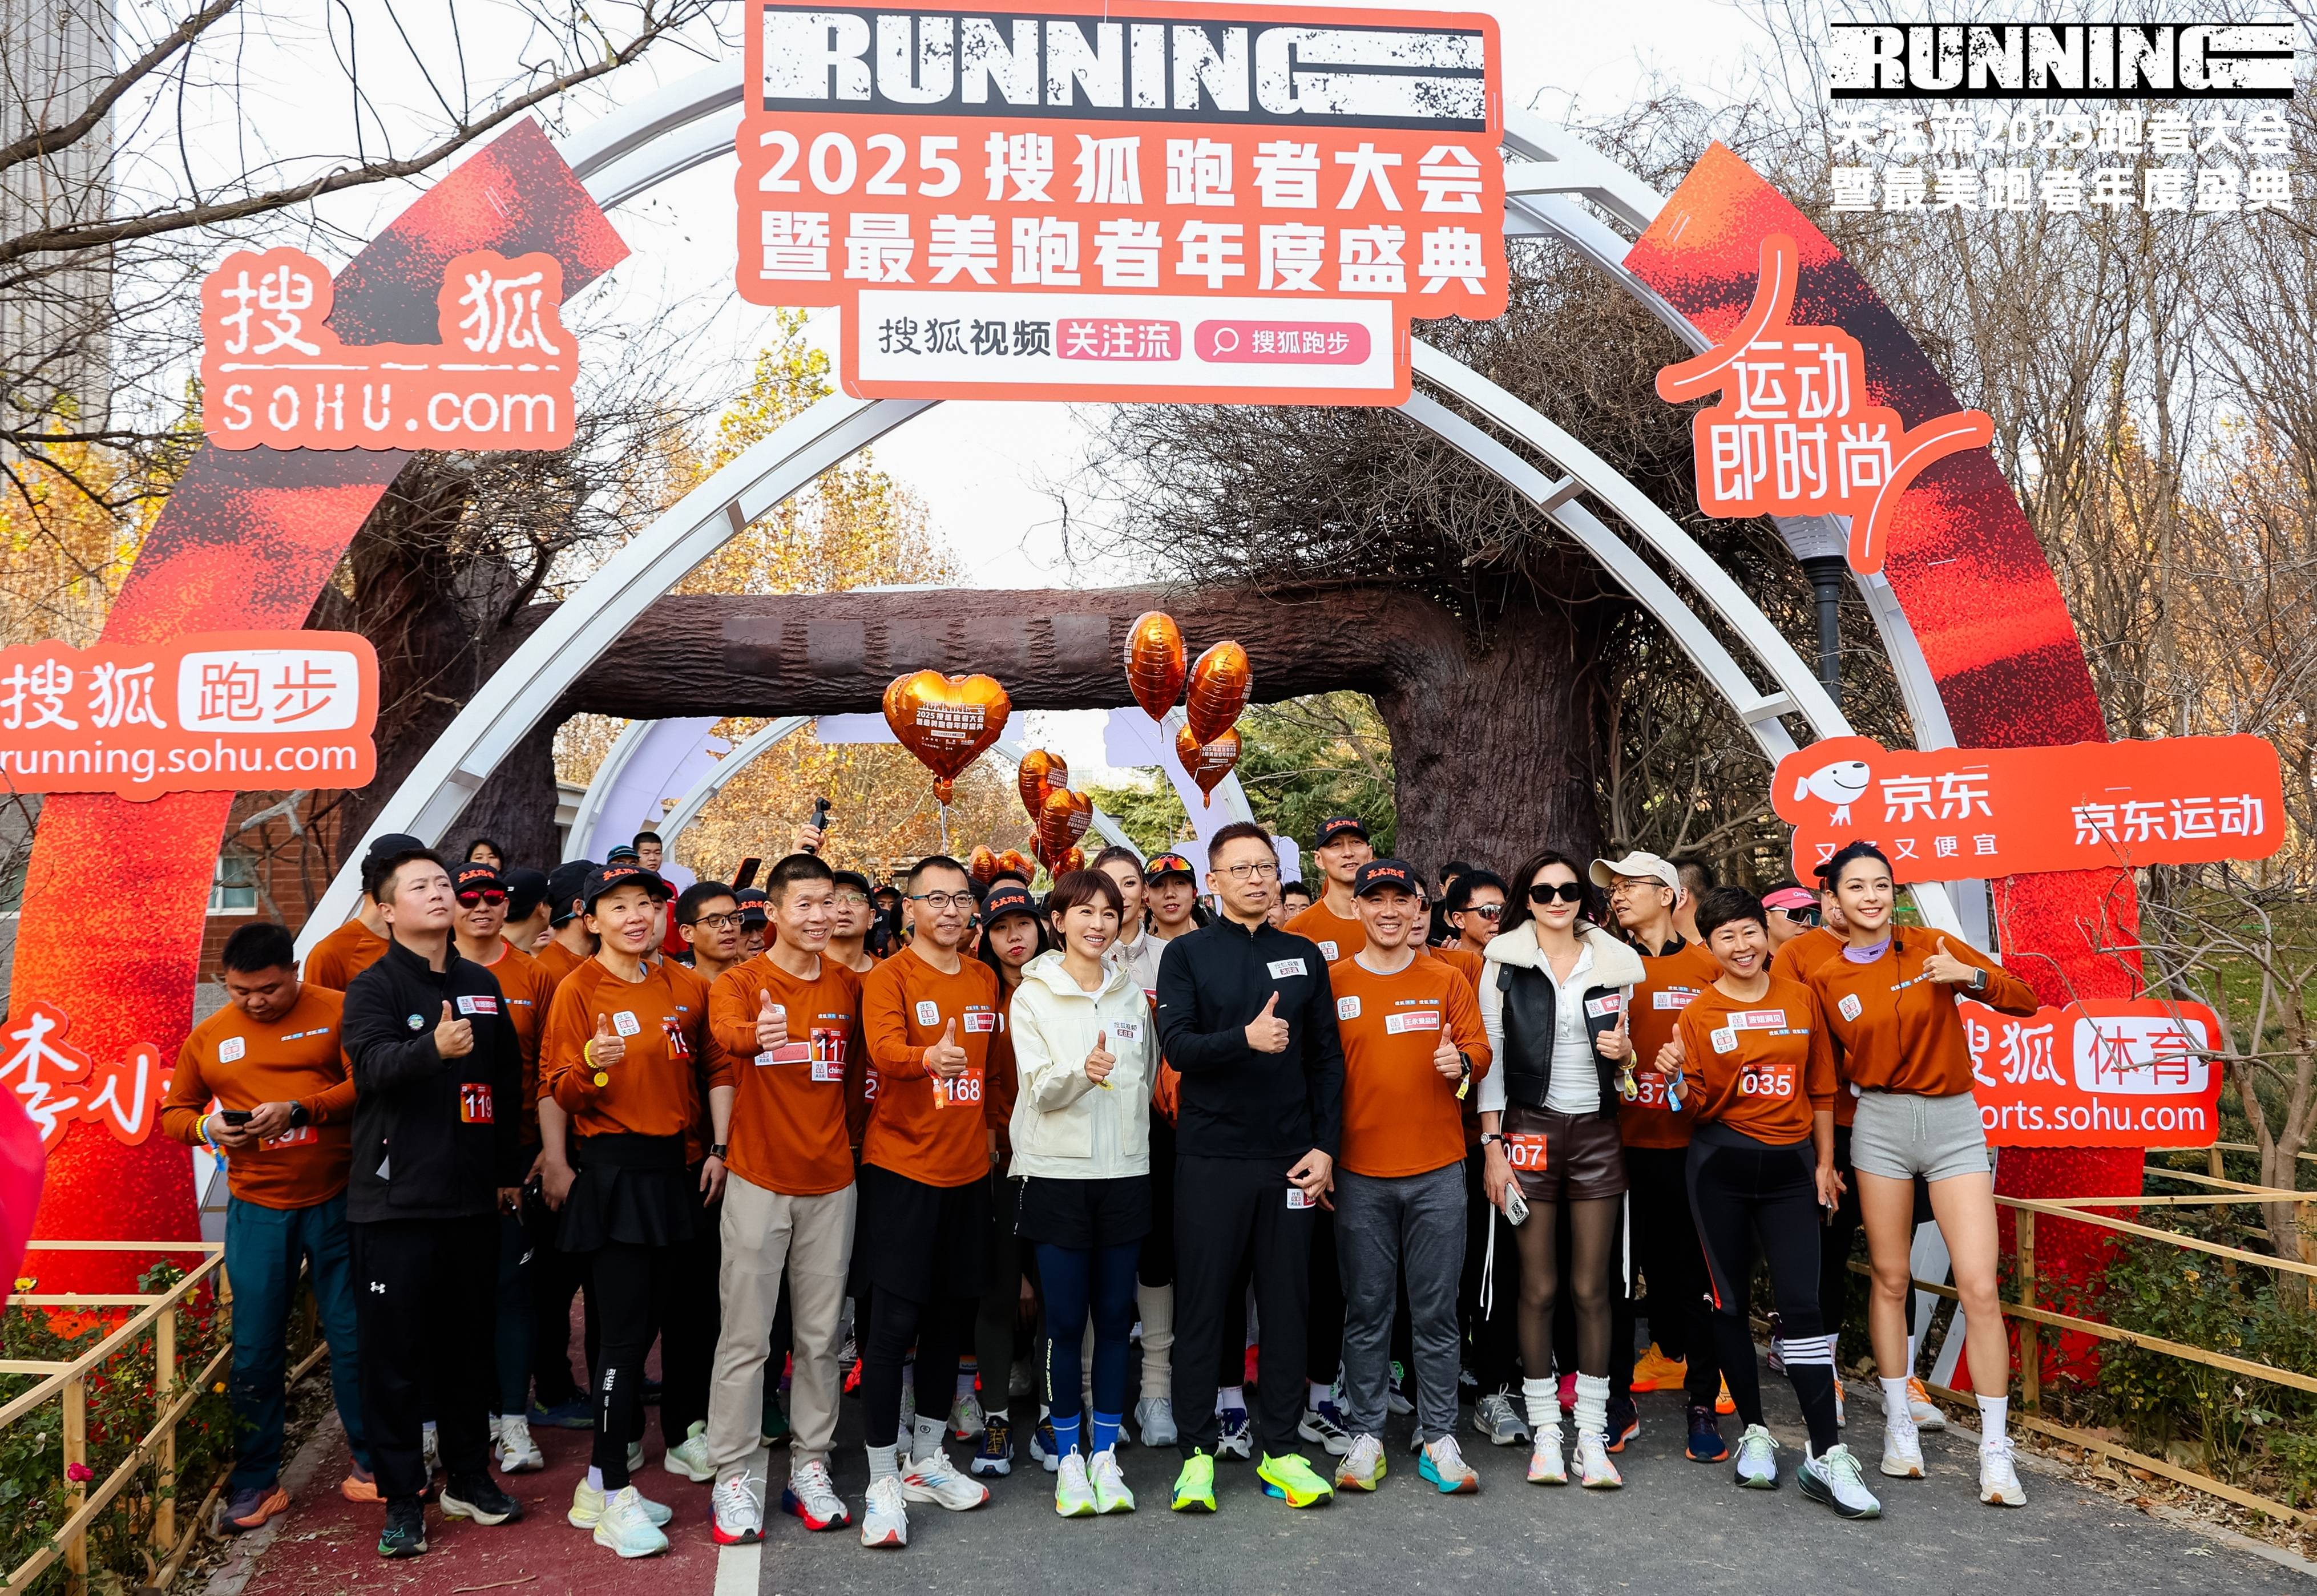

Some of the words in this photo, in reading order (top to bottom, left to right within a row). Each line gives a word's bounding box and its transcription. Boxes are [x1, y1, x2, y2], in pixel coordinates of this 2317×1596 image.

[764, 11, 1486, 119] RUNNING
[758, 131, 1483, 213] 2025搜狐跑者大会
[760, 210, 1486, 297] 暨最美跑者年度盛典
[220, 265, 560, 356] 搜狐
[879, 318, 1051, 357] 搜狐视频
[1067, 321, 1173, 360] 关注流
[1252, 330, 1350, 355] 搜狐跑步
[223, 383, 555, 433] SOHU.com
[1733, 340, 1849, 420] 运动
[1710, 422, 1892, 500] 即时尚
[0, 658, 167, 730] 搜狐
[197, 660, 337, 724] 跑步
[0, 738, 357, 782] running.sohu.com
[1879, 771, 1993, 823] 京东
[2072, 793, 2264, 846] 京东运动
[1815, 834, 1998, 865] 又又便宜
[0, 1012, 171, 1142] 李小
[817, 1038, 847, 1062] 117
[2087, 1025, 2193, 1088] 体育
[466, 1094, 493, 1118] 119
[944, 1078, 981, 1101] 168
[1742, 1073, 1791, 1096] 035
[1980, 1097, 2205, 1132] orts.sohu.com
[605, 1368, 616, 1391] RUN
